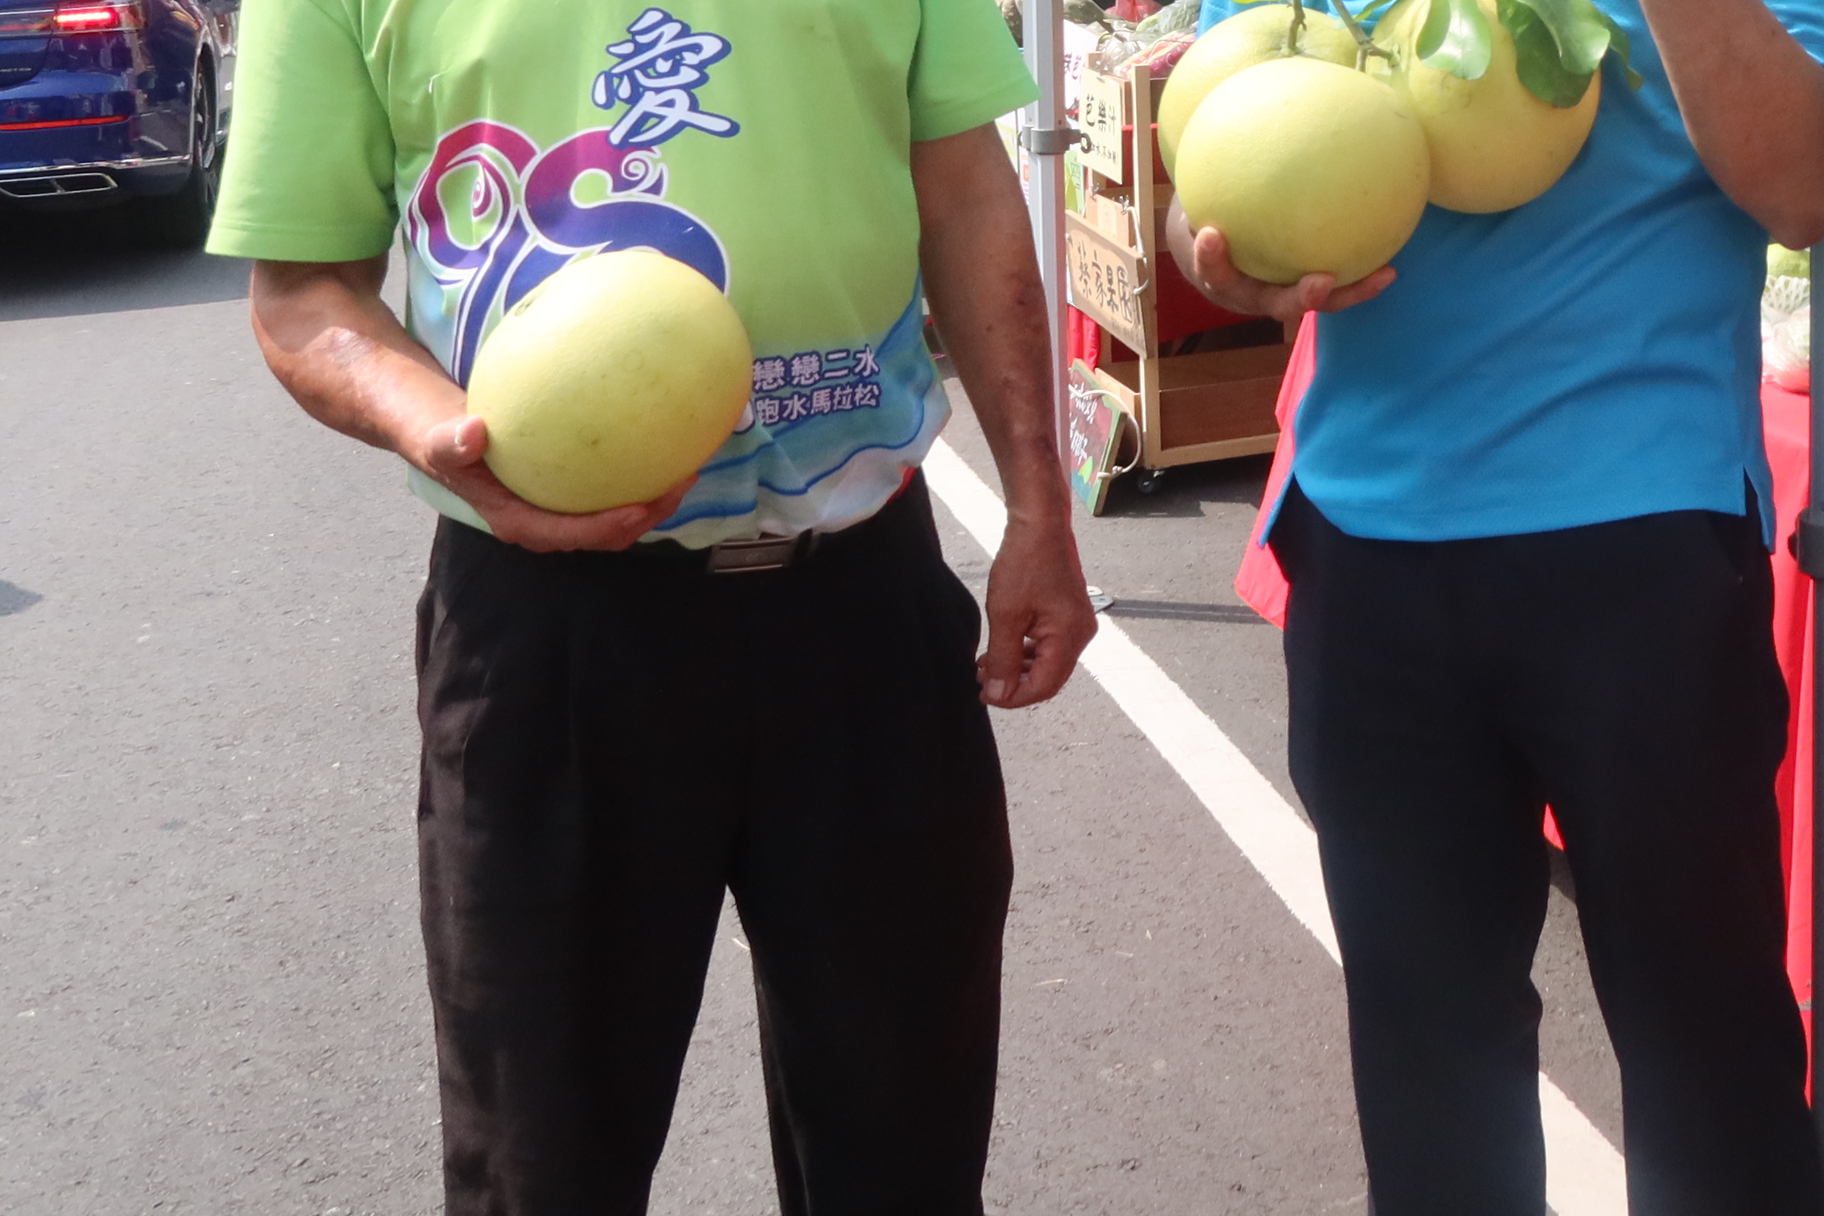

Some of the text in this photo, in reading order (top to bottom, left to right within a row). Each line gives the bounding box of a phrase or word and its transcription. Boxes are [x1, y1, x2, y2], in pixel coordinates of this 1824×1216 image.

[592, 7, 741, 150] 愛
[752, 346, 880, 390] 戀戀二水
